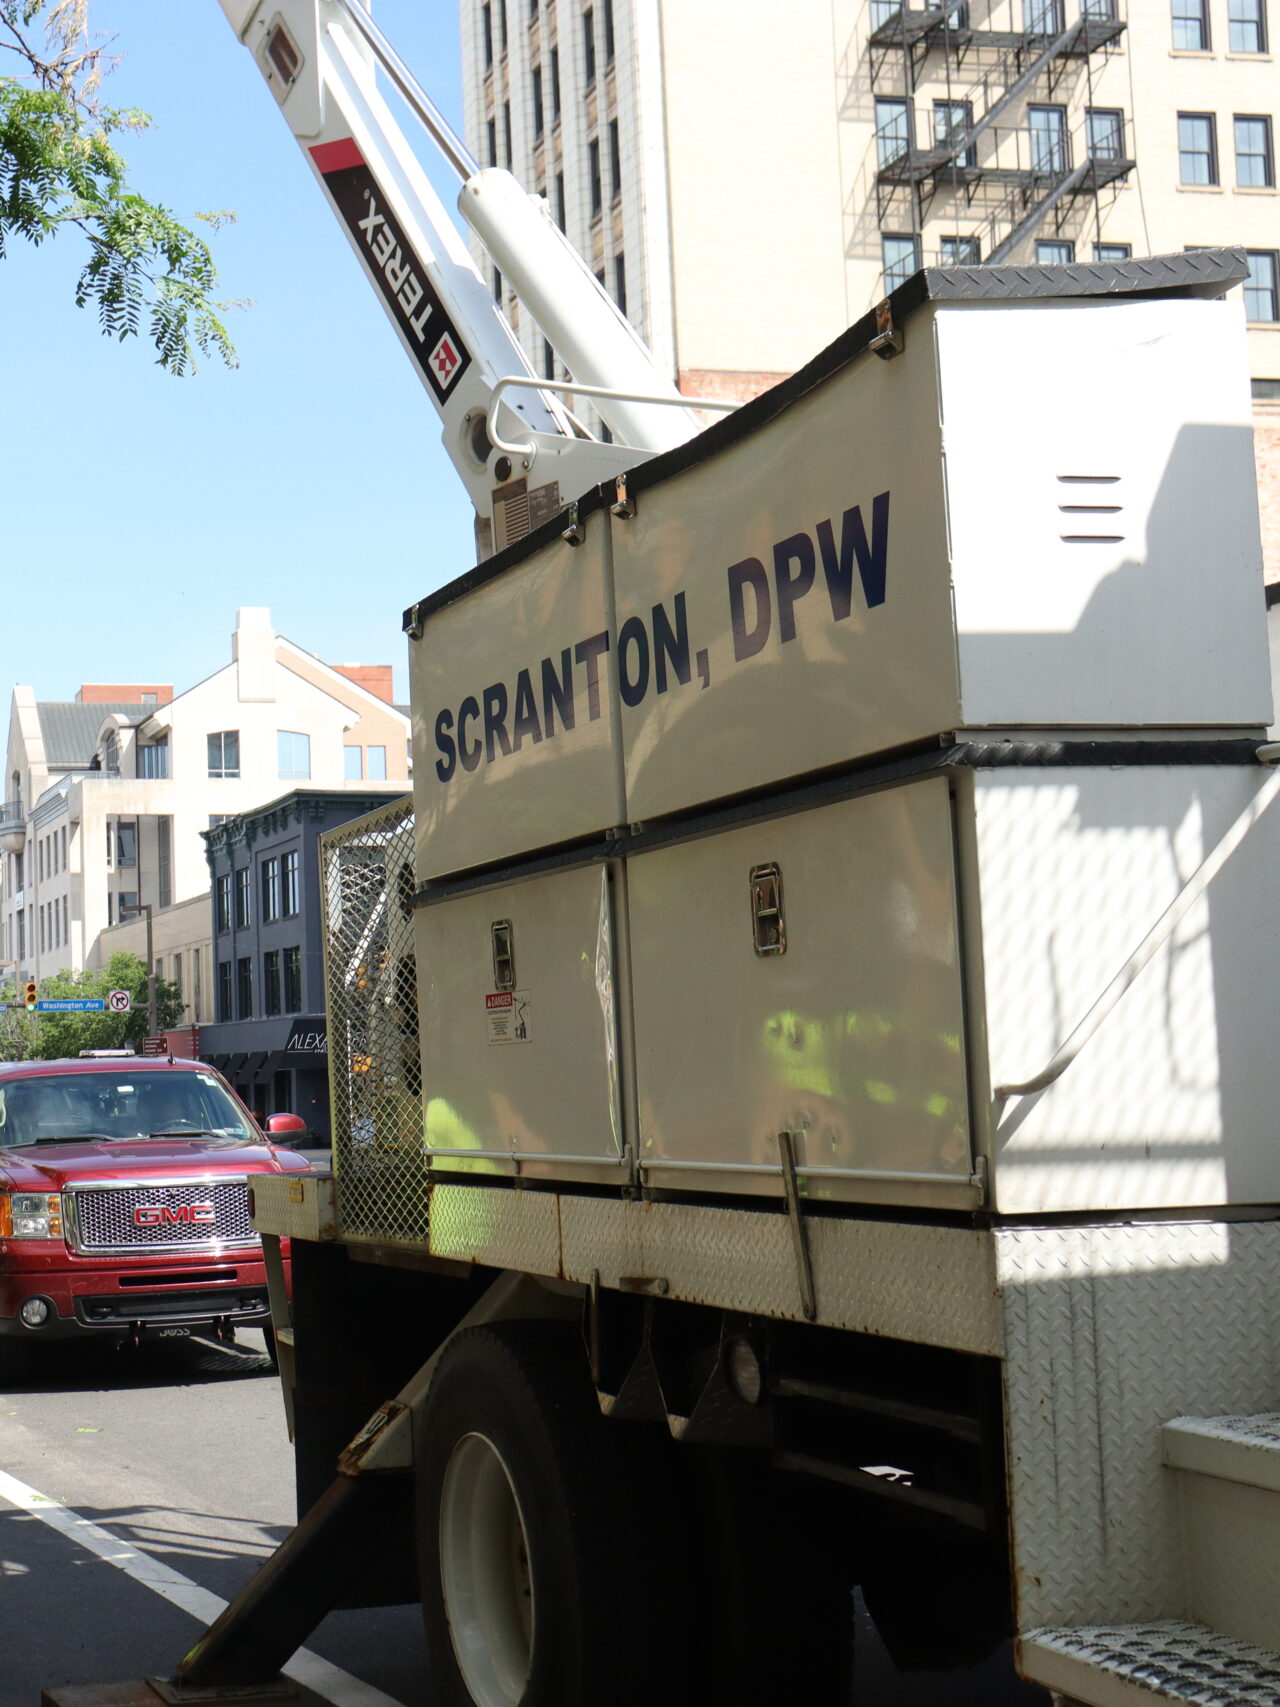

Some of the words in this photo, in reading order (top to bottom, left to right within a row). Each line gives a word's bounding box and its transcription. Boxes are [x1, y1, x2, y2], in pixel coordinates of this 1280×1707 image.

[435, 590, 710, 783] SCRANTON,
[727, 490, 890, 663] DPW
[42, 1001, 83, 1009] Washington
[491, 994, 512, 1007] DANGER
[134, 1204, 215, 1226] GMC
